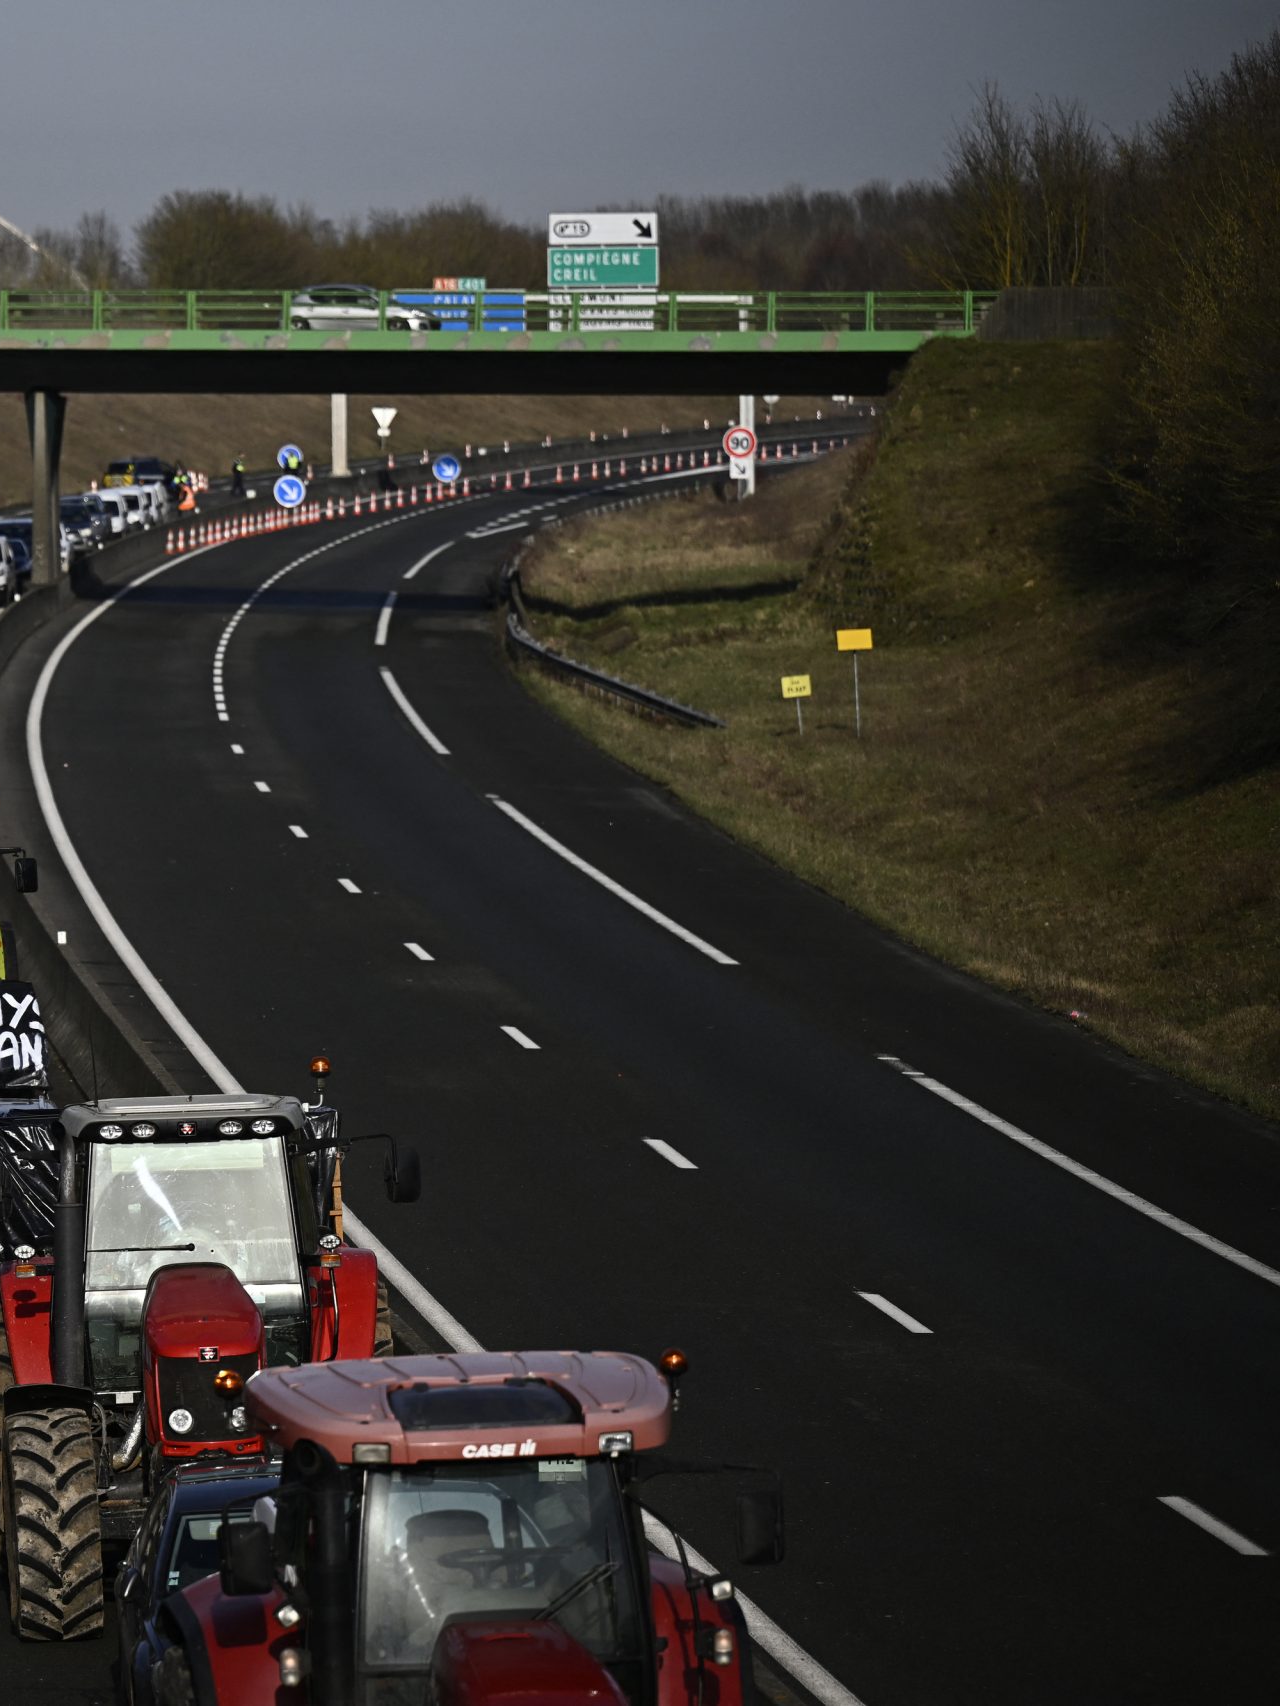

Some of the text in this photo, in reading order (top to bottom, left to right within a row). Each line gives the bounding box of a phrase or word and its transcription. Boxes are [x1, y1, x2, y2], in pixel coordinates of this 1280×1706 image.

[553, 251, 640, 266] COMPIÈGNE
[553, 268, 597, 281] CREIL
[731, 437, 749, 450] 90
[462, 1443, 516, 1458] CASE
